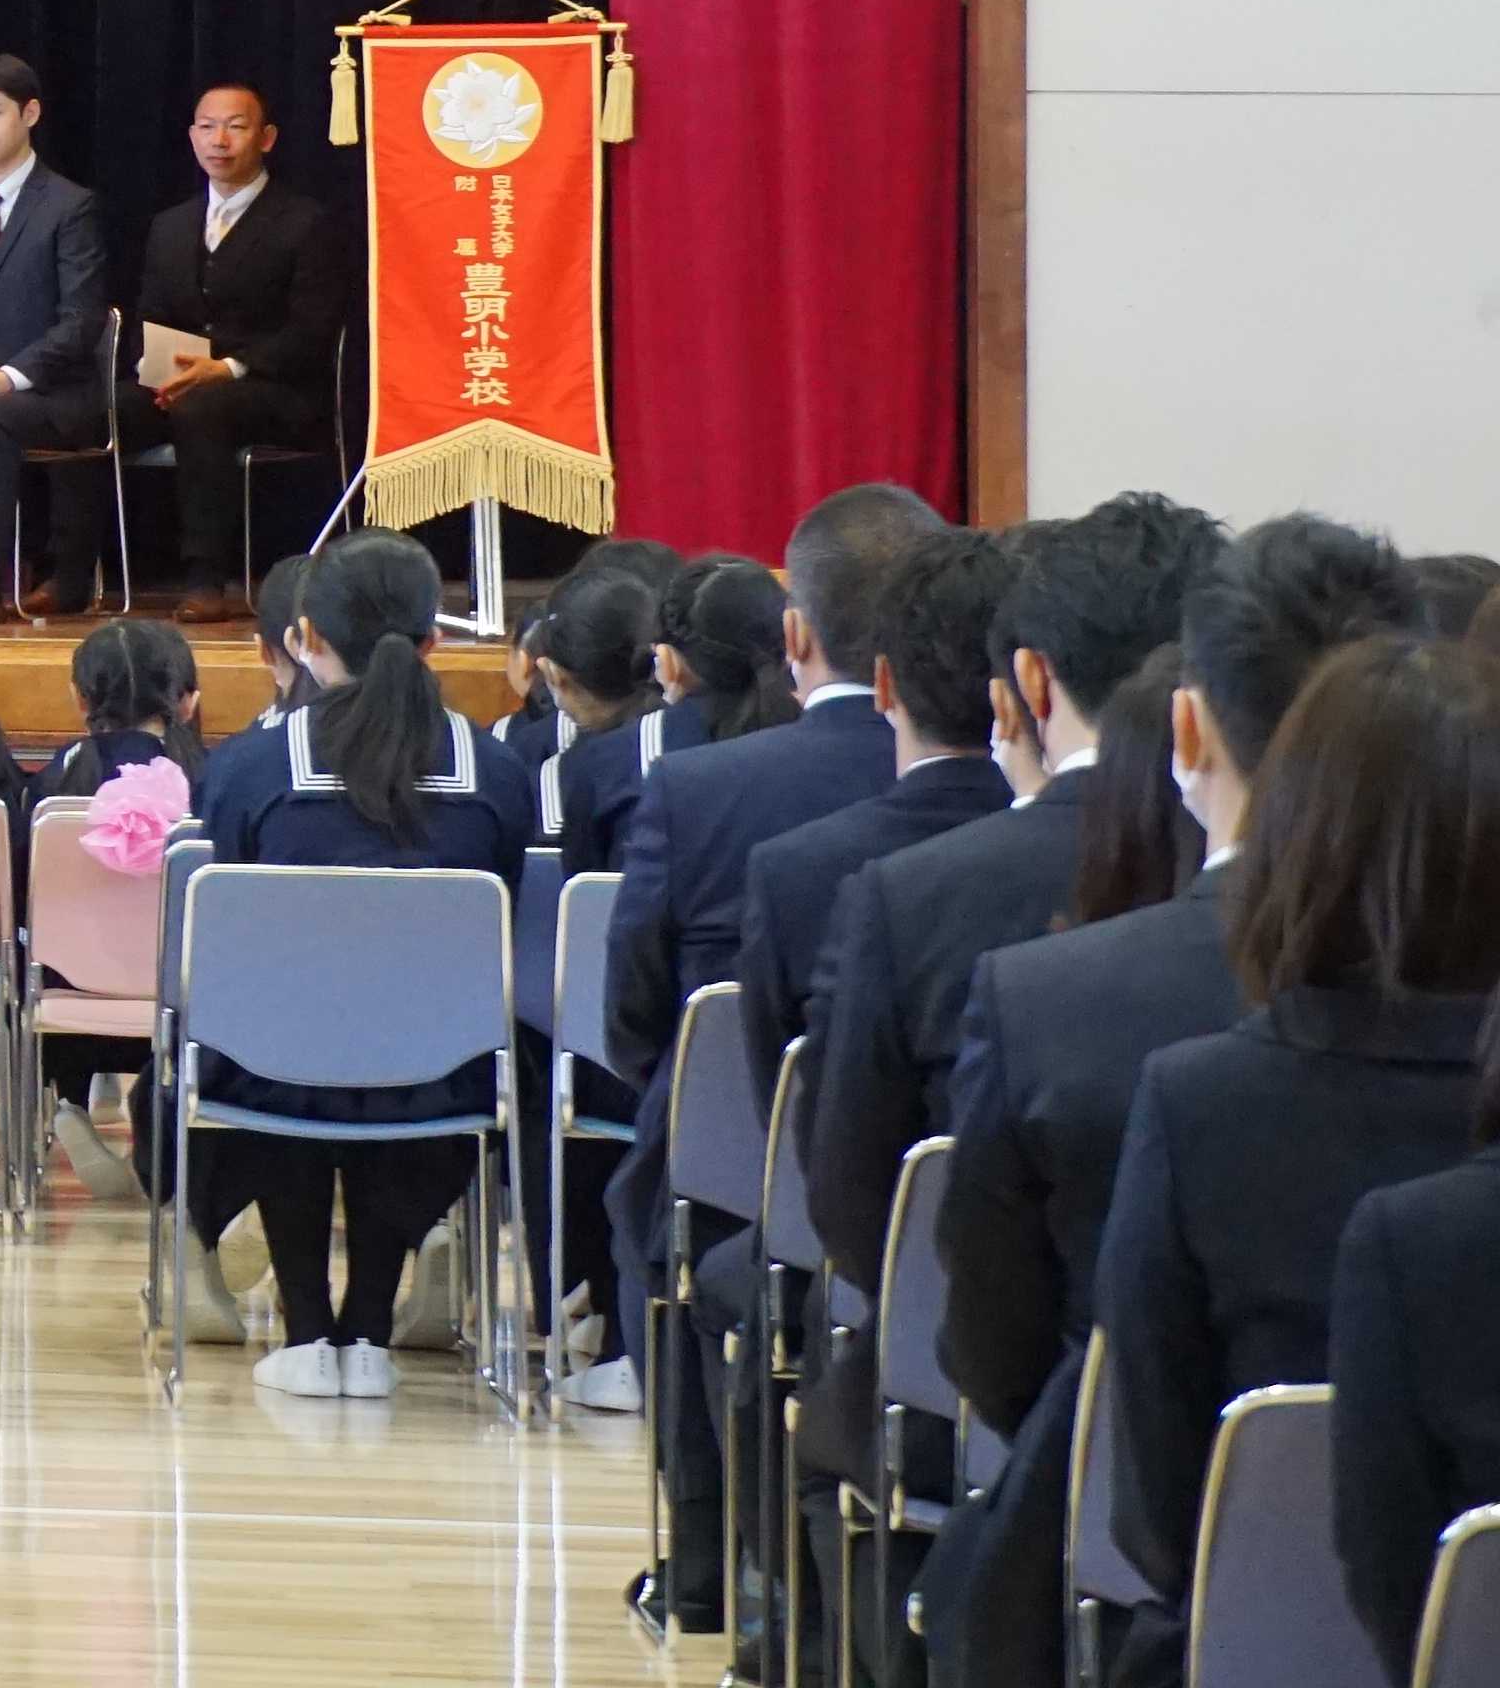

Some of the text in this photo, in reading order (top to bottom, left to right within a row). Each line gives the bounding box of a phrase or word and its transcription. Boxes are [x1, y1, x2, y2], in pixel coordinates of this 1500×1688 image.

[488, 174, 515, 259] 日本女子大学
[459, 262, 513, 407] 豊明小学校
